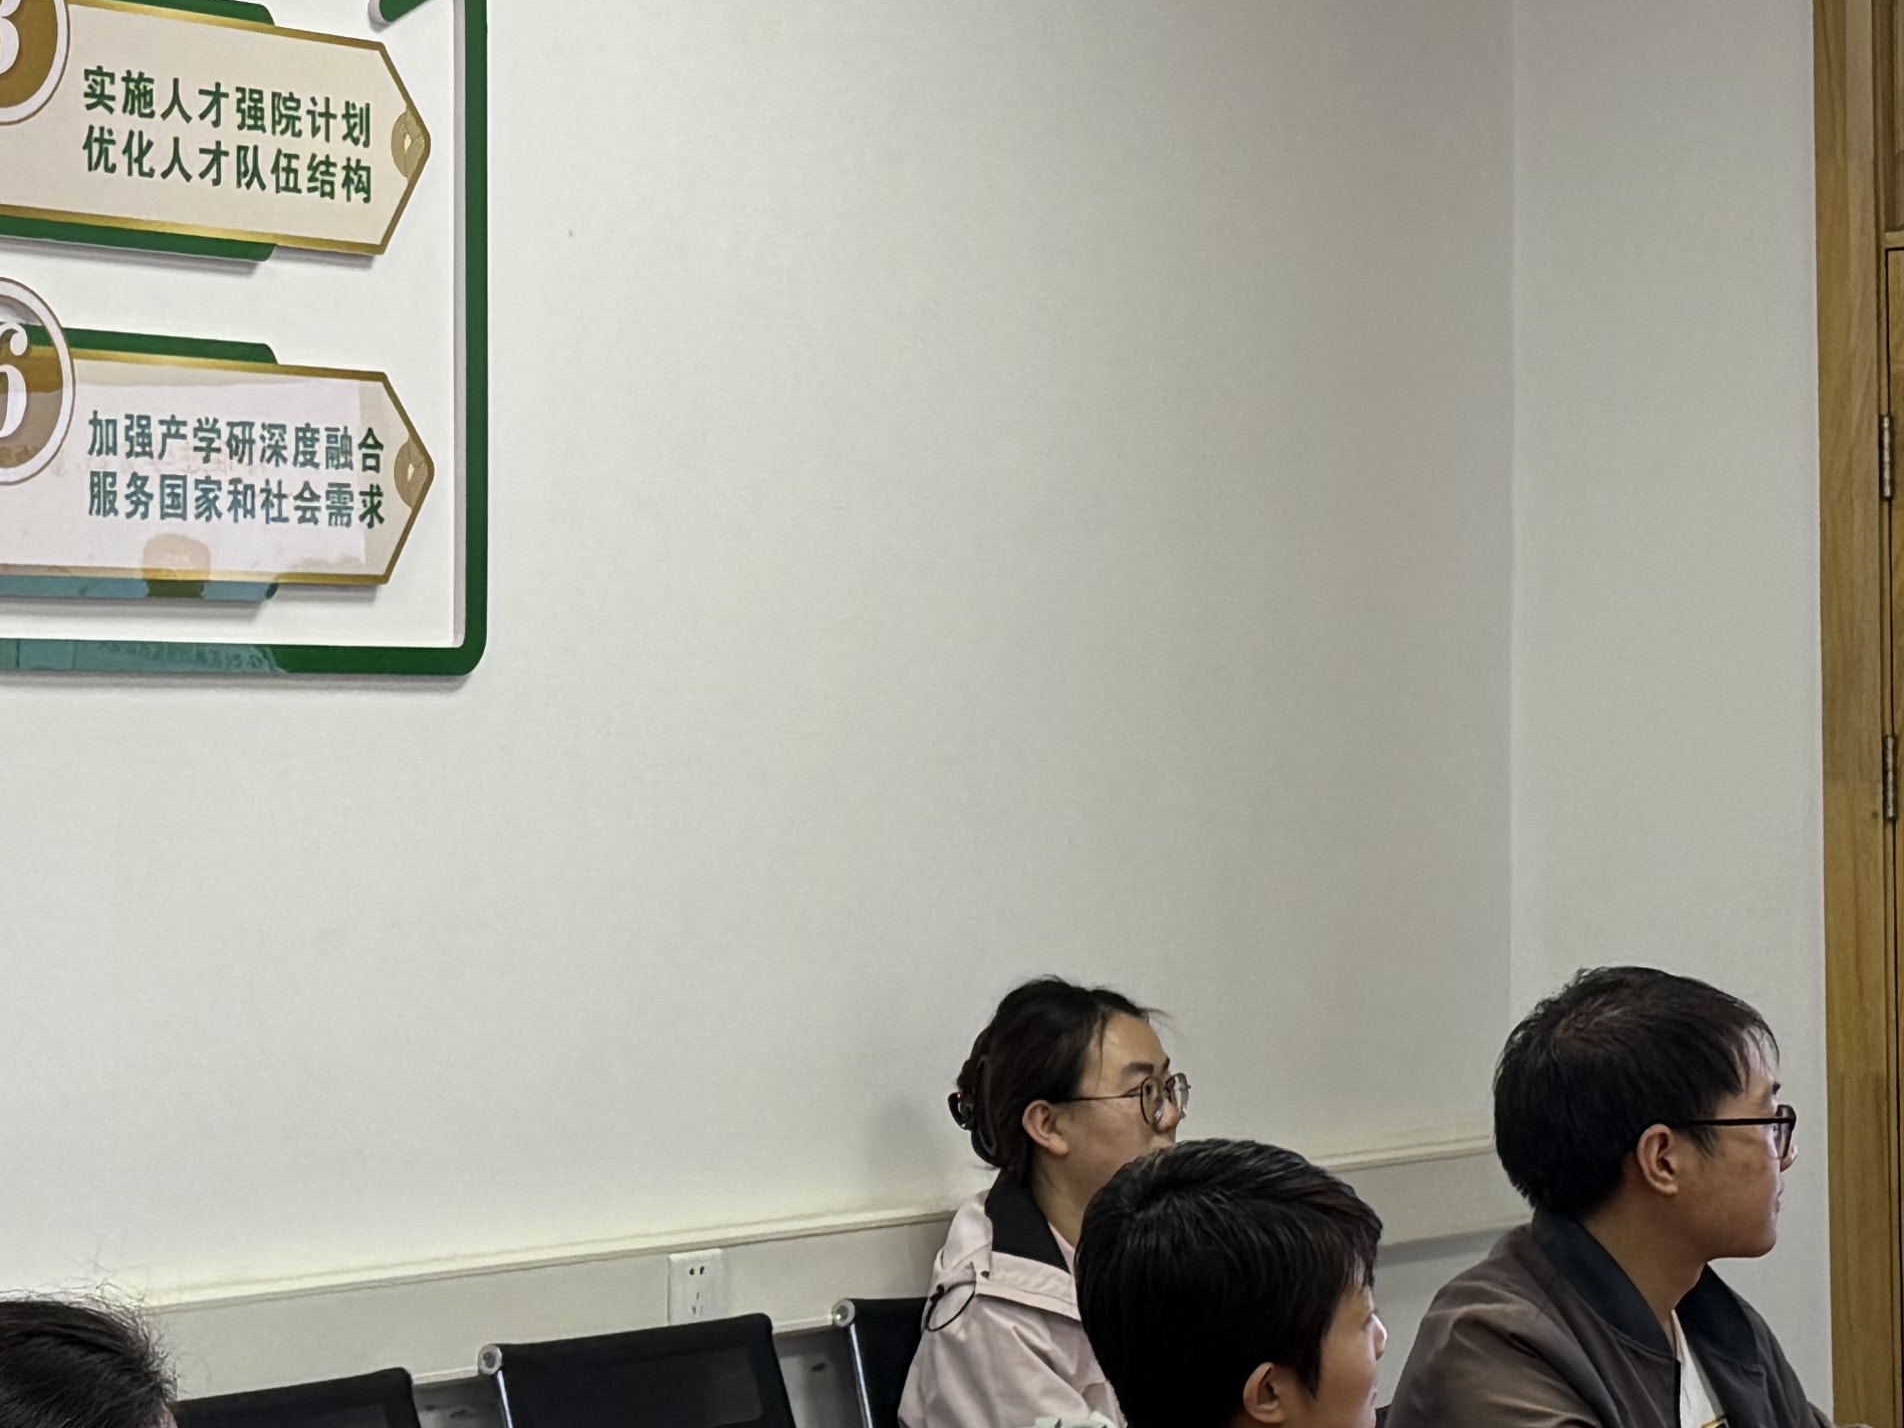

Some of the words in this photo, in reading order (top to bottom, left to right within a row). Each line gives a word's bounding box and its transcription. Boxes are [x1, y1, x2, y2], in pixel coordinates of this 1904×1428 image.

[82, 65, 371, 149] 实施人才强院计划
[82, 124, 372, 204] 优化人才队伍结构
[87, 410, 385, 474] 加强产学研深度融合
[88, 470, 385, 529] 服务国家和社会需求
